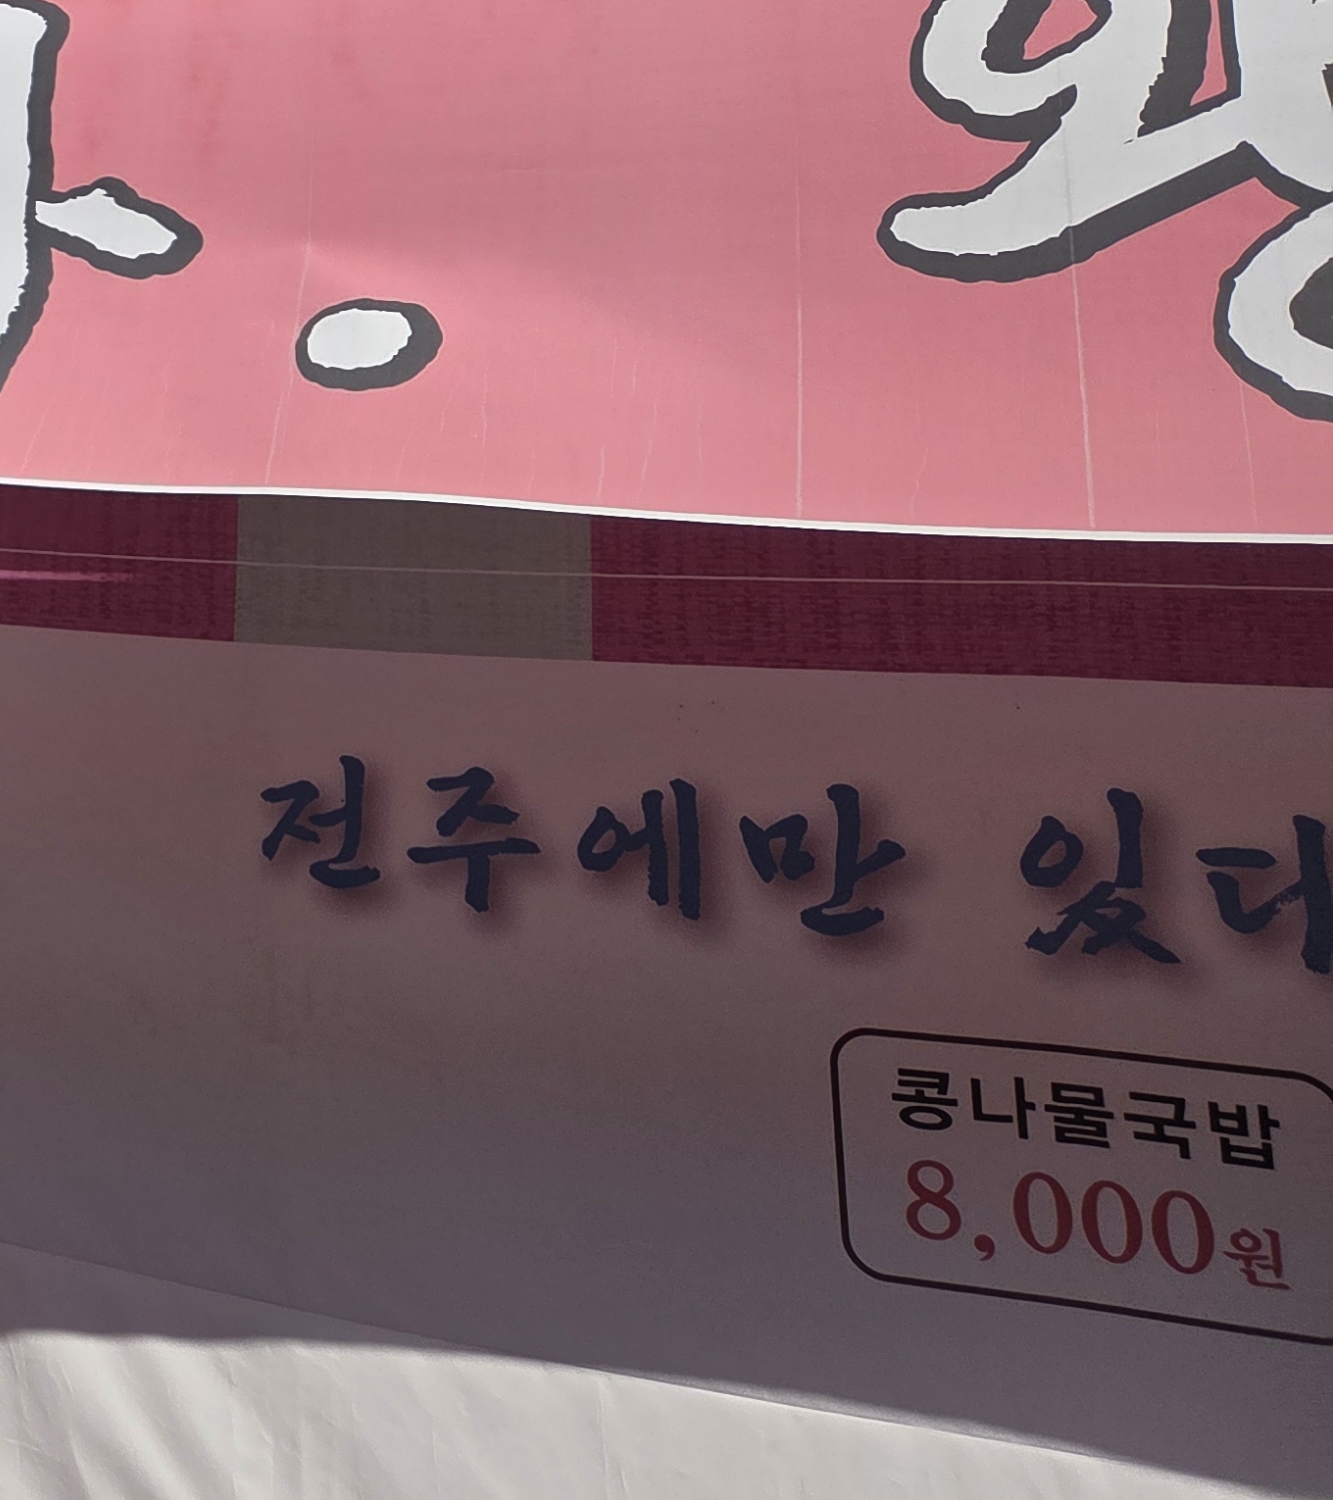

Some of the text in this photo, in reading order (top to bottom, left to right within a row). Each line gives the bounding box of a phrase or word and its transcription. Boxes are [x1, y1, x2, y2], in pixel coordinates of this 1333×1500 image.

[259, 754, 905, 938] 전주에만
[890, 1065, 1283, 1171] 콩나물국밥
[904, 1158, 1291, 1292] 8,000원
